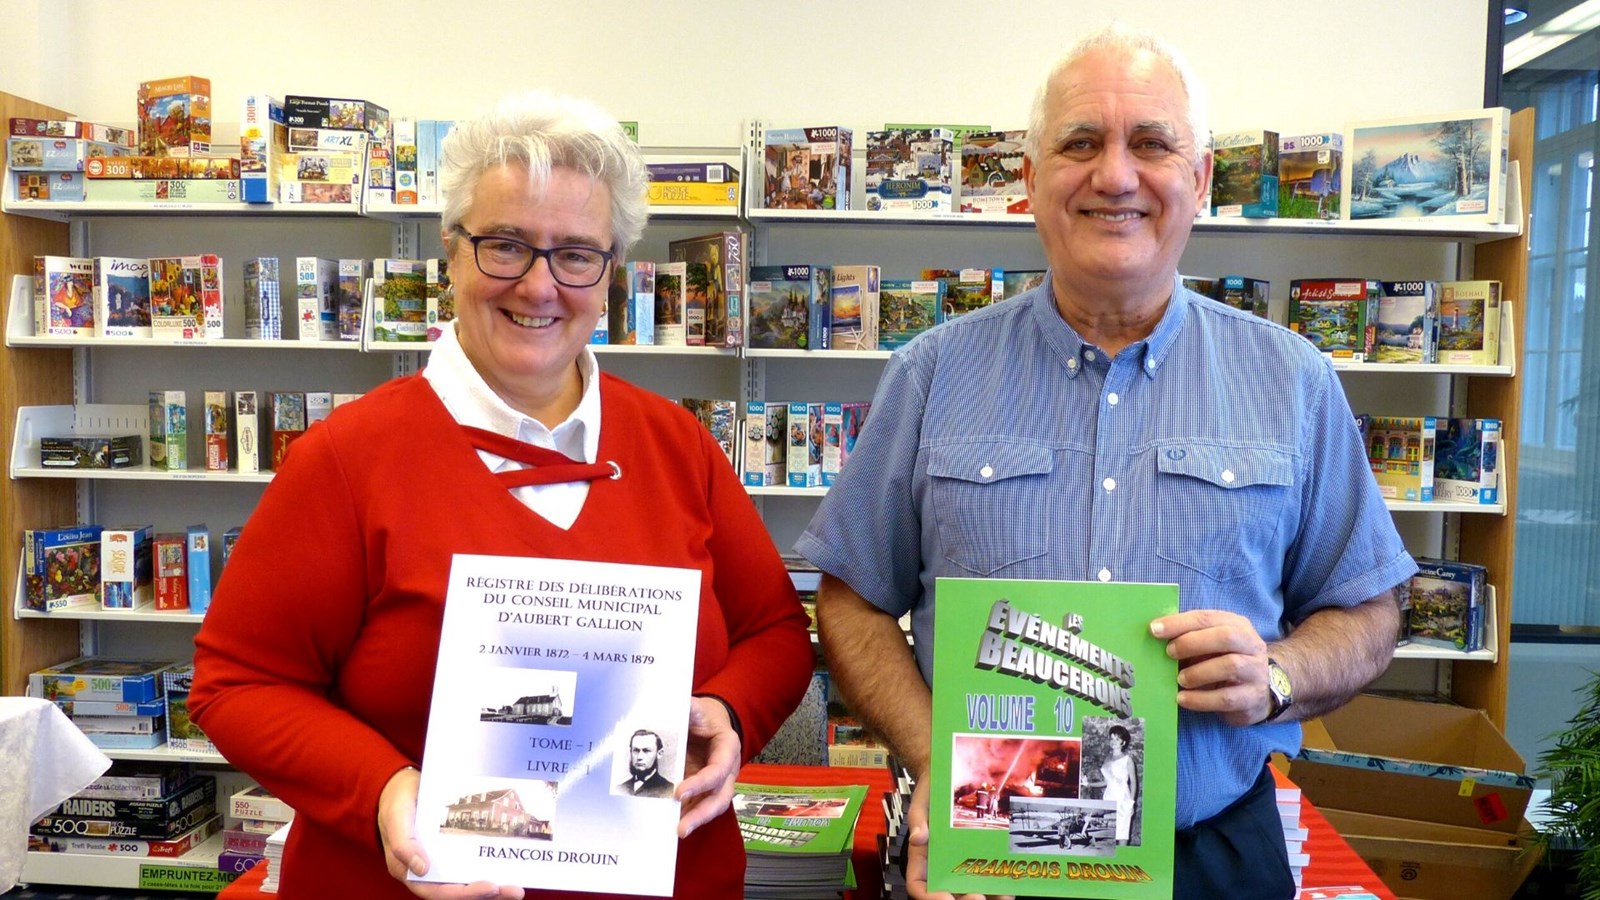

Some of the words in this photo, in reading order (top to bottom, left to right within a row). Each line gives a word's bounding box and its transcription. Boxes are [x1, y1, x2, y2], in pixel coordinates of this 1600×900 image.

[818, 129, 836, 137] 1000
[340, 136, 352, 146] XL
[1300, 136, 1322, 146] 1000
[106, 165, 125, 175] 300
[912, 200, 932, 209] 1000
[300, 272, 314, 280] 500
[794, 267, 808, 276] 1000
[1403, 282, 1424, 291] 1000
[183, 319, 196, 328] 500
[1456, 486, 1474, 496] 1000
[467, 576, 534, 591] RÉGISTRE
[539, 581, 564, 592] DES
[569, 582, 682, 601] DÉLIBÉRATIONS
[484, 593, 506, 604] DU
[511, 595, 572, 608] CONSEIL
[578, 599, 662, 616] MUNICIPAL
[498, 612, 570, 626] D'AUBERT
[577, 618, 643, 632] GALLION
[1064, 612, 1084, 635] LES
[479, 644, 486, 654] 2
[488, 646, 541, 658] JANVIER
[546, 648, 570, 659] 1872
[582, 651, 589, 660] 4
[592, 652, 628, 664] MARS
[631, 654, 654, 665] 1879
[975, 631, 1133, 719] BEAUCERONS
[92, 678, 110, 690] 500
[966, 694, 1036, 732] VOLUME
[1054, 696, 1074, 732] 10
[530, 737, 572, 751] TOME
[588, 741, 592, 752] 1
[527, 760, 568, 774] LIVRE
[63, 800, 116, 818] RAIDERS
[53, 819, 88, 834] 500
[174, 814, 194, 834] 500
[111, 827, 138, 836] PUZZLE
[120, 844, 138, 852] 500
[478, 846, 554, 862] FRANÇOIS
[558, 851, 618, 866] DROUIN
[952, 858, 1061, 880] FRANÇOIS
[1066, 862, 1153, 882] DROUIN
